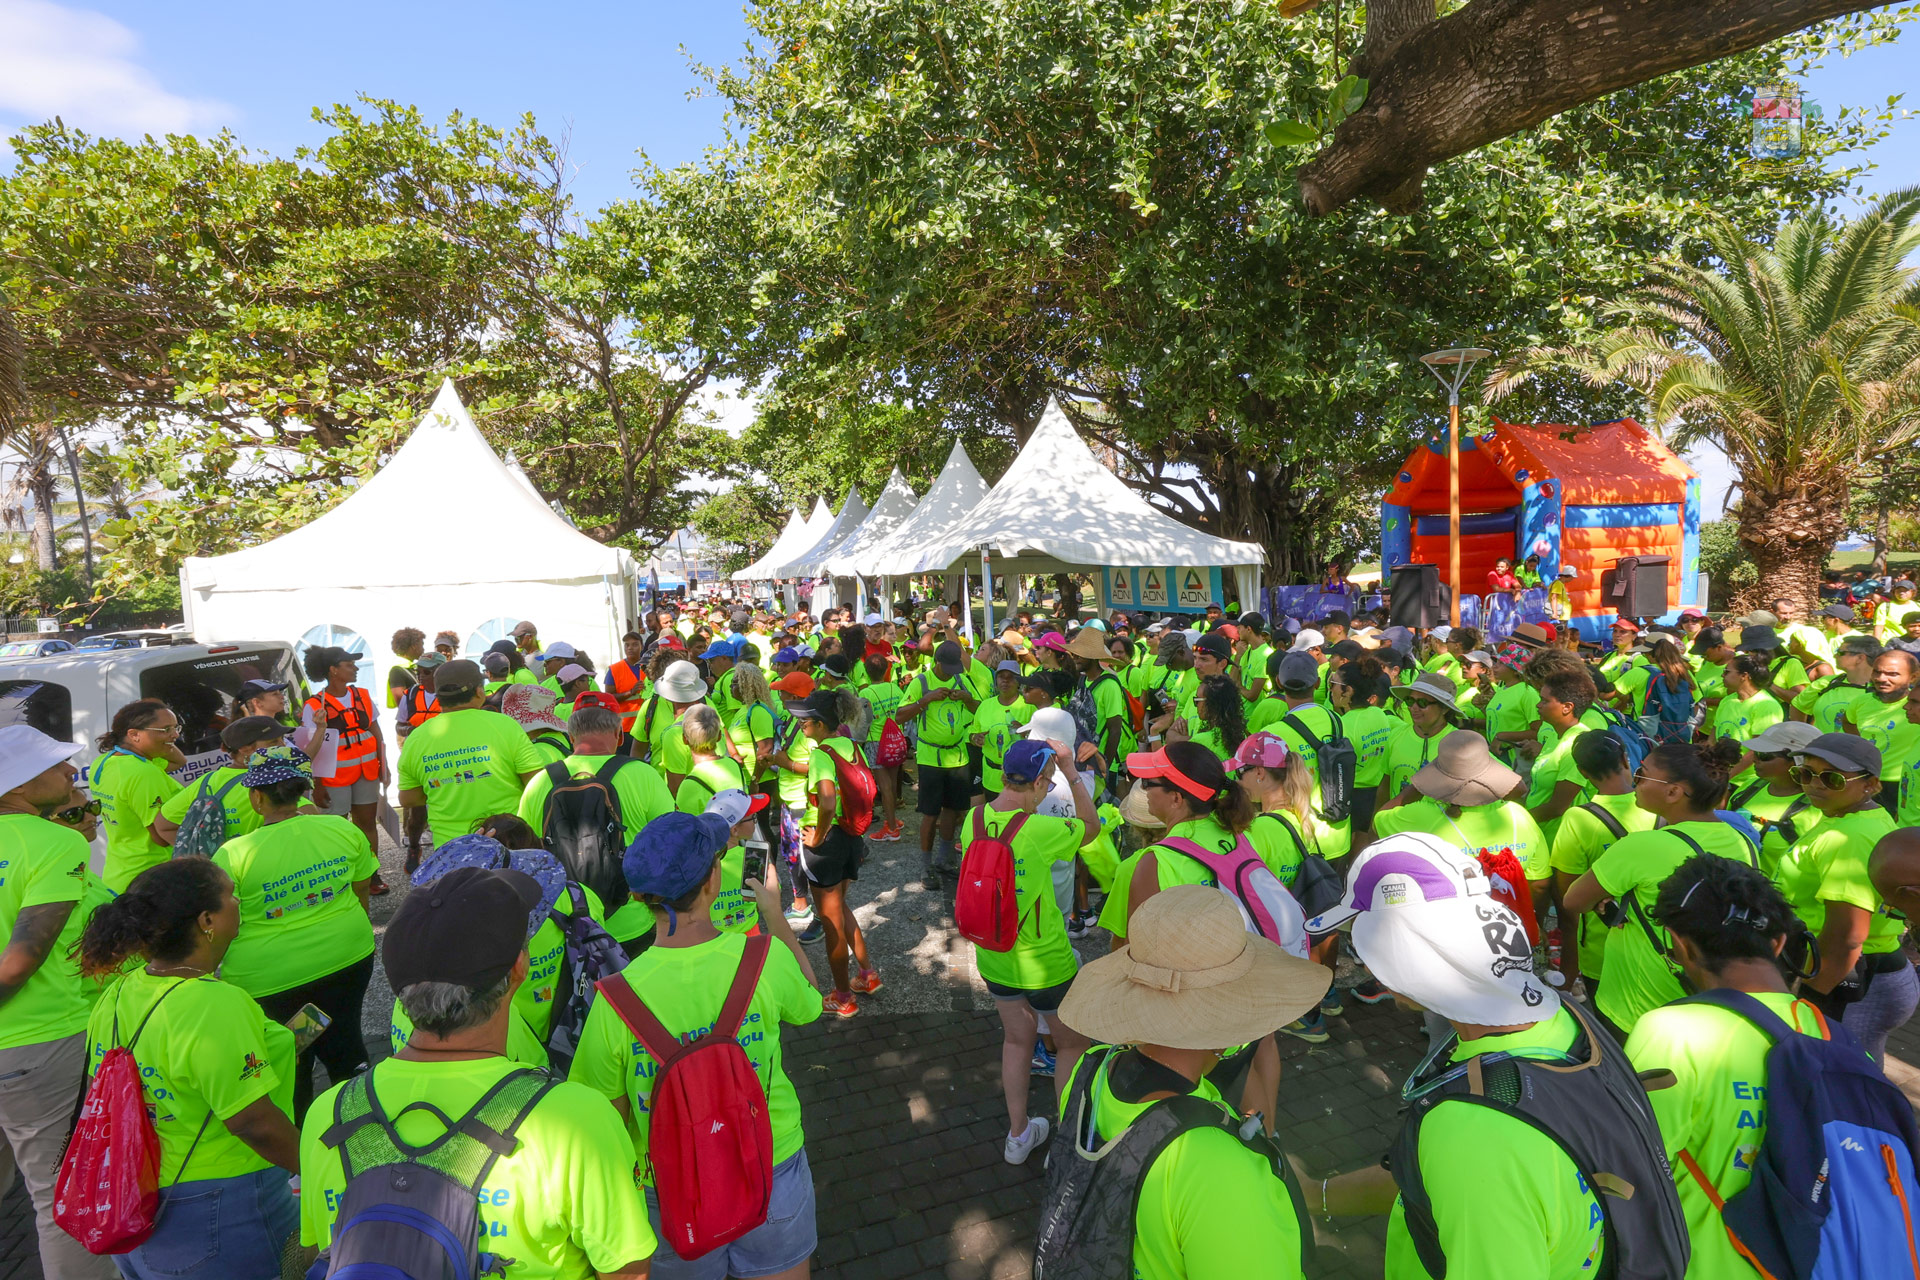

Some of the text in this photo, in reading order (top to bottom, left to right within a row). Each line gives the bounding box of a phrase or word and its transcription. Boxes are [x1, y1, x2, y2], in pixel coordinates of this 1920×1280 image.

[1142, 591, 1164, 601] ADN
[1180, 591, 1207, 602] ADN
[422, 745, 488, 763] Endometriose
[424, 755, 490, 773] Alé di partou
[262, 855, 347, 891] Endometriose
[263, 866, 349, 903] Alé di partou
[1382, 883, 1405, 893] CANAL
[713, 899, 724, 911] di
[530, 963, 557, 981] Alé
